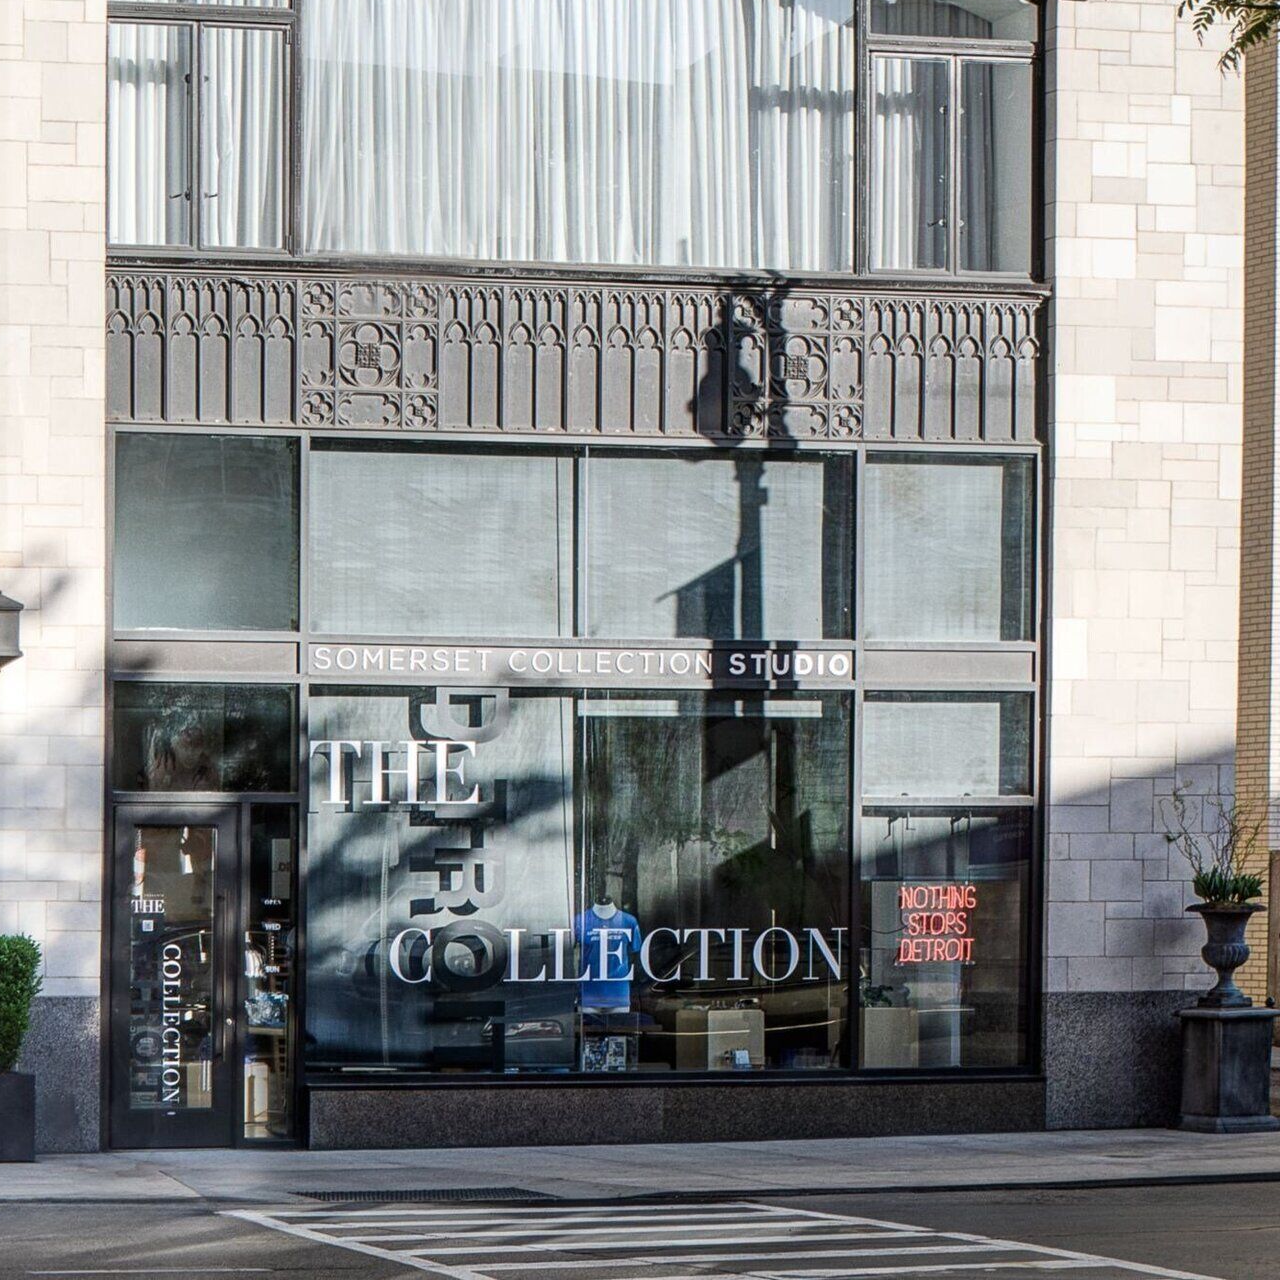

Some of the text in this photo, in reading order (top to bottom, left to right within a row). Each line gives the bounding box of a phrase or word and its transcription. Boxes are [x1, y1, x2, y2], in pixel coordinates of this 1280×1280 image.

[314, 647, 849, 676] SOMERSET COLLECTION STUDIO
[310, 740, 479, 805] THE
[131, 899, 165, 913] THE
[900, 885, 976, 909] NOTHING
[907, 912, 967, 936] STOPS
[389, 923, 848, 984] COLLECTION
[899, 938, 975, 962] DETROIT
[162, 944, 182, 1104] COLLECTION
